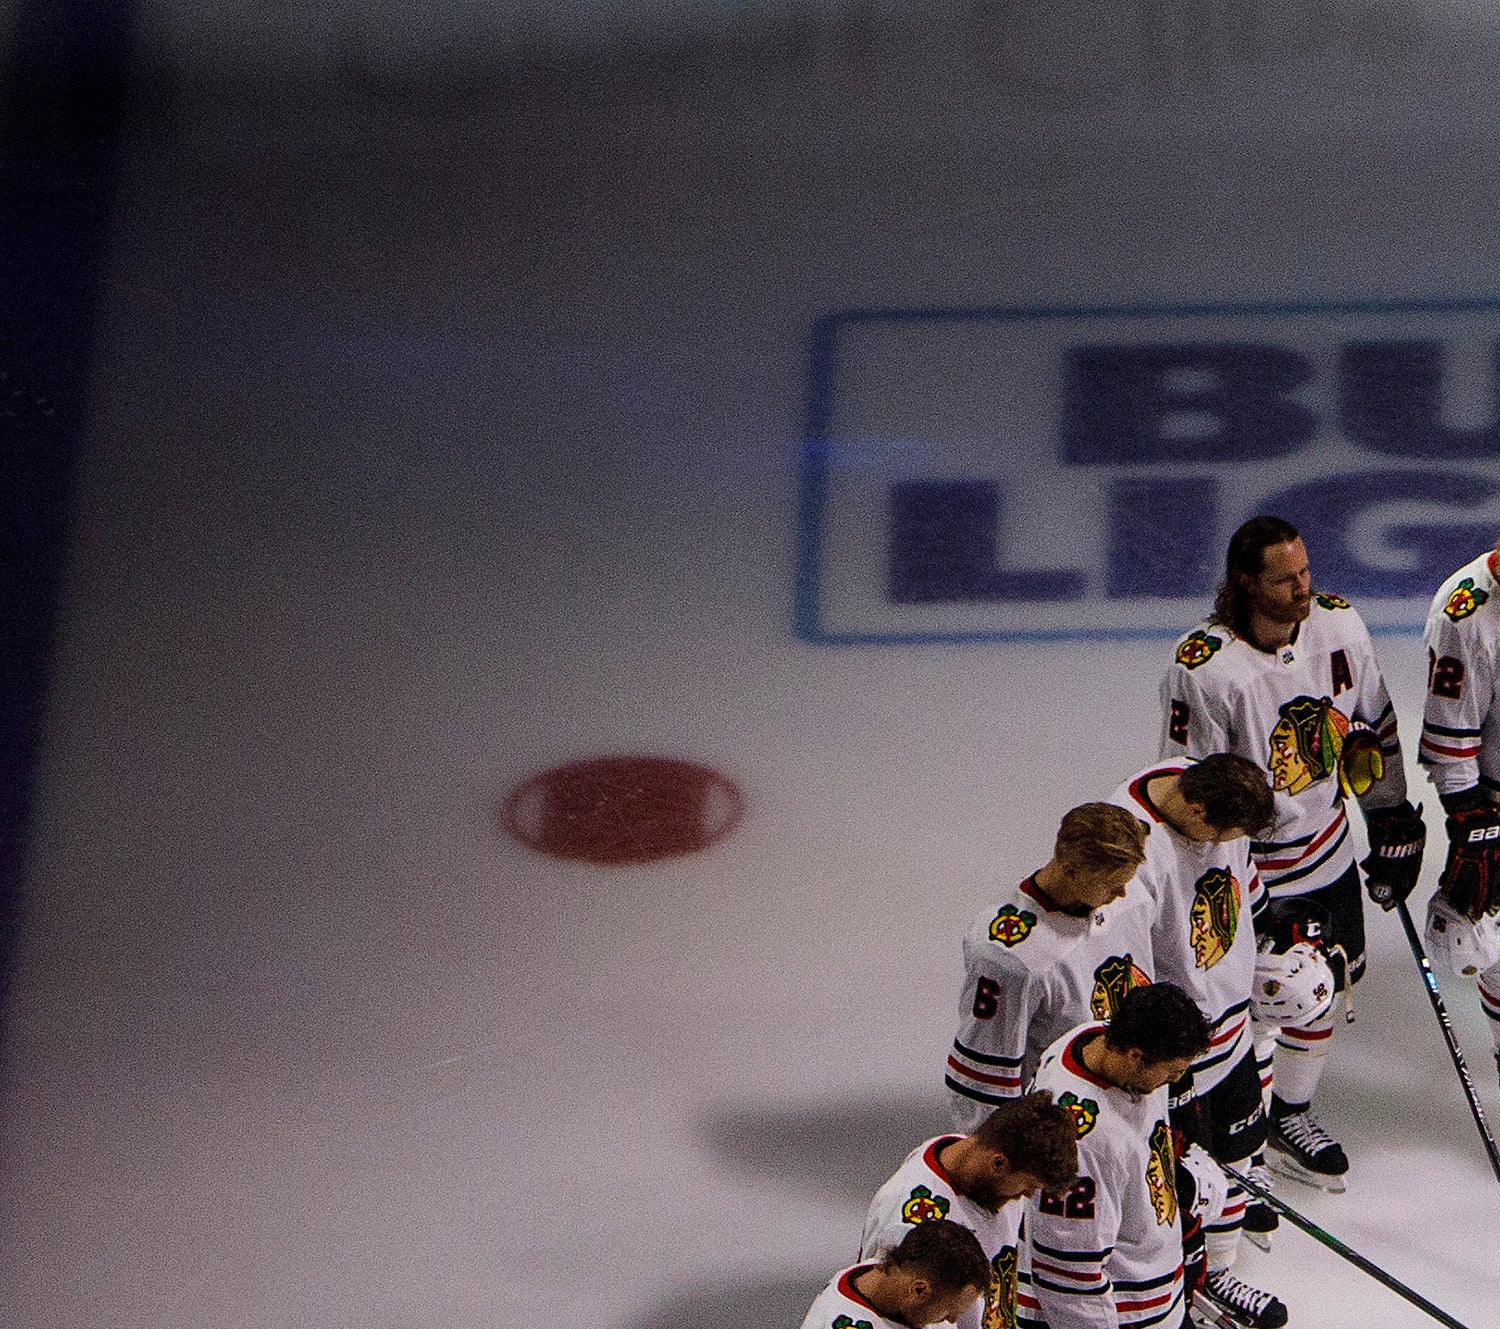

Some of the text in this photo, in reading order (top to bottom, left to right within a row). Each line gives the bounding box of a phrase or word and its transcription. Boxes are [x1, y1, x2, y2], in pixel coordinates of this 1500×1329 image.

[1329, 648, 1355, 698] A
[1170, 698, 1192, 747] 2
[1041, 1174, 1096, 1220] 2
